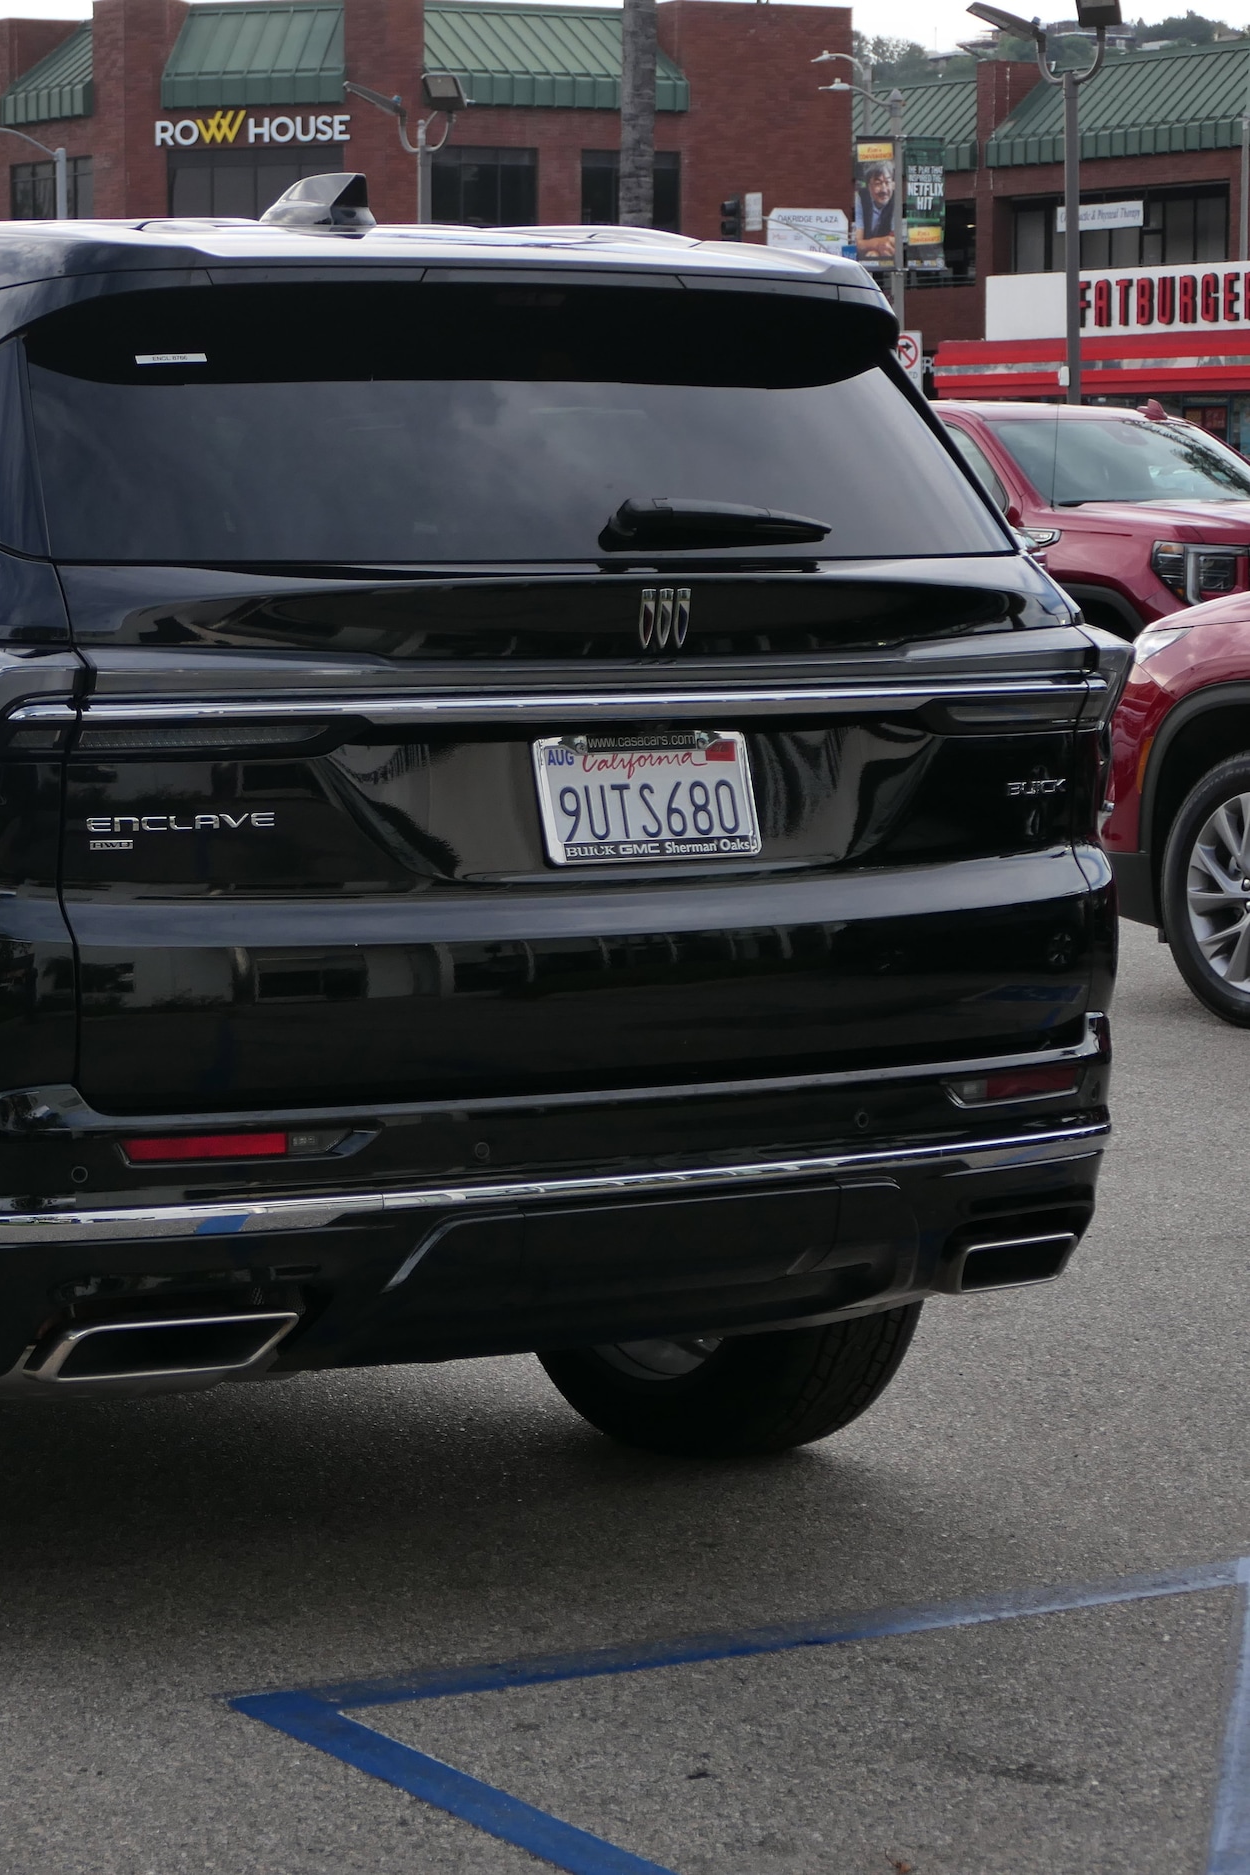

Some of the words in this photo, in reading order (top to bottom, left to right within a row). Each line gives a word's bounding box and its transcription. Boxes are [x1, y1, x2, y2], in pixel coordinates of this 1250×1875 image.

[248, 114, 352, 144] HOUSE
[908, 165, 917, 174] THE
[918, 165, 930, 174] PLAY
[931, 165, 943, 174] THAT
[932, 174, 942, 182] THE
[907, 182, 944, 197] NETFLIX
[916, 196, 934, 210] HIT
[777, 213, 812, 224] OAKRIDGE
[815, 214, 839, 223] PLAZA
[587, 733, 695, 749] www.casacars.com
[547, 749, 575, 767] AUG
[581, 750, 709, 780] California
[1006, 778, 1067, 796] BUICK
[558, 778, 741, 843] 9UTS680
[86, 811, 276, 833] ENCLAVE
[92, 841, 131, 849] AWD
[565, 844, 616, 859] BUICK
[618, 842, 661, 855] GMC
[665, 840, 718, 855] Sherman
[720, 837, 751, 853] Oaks
